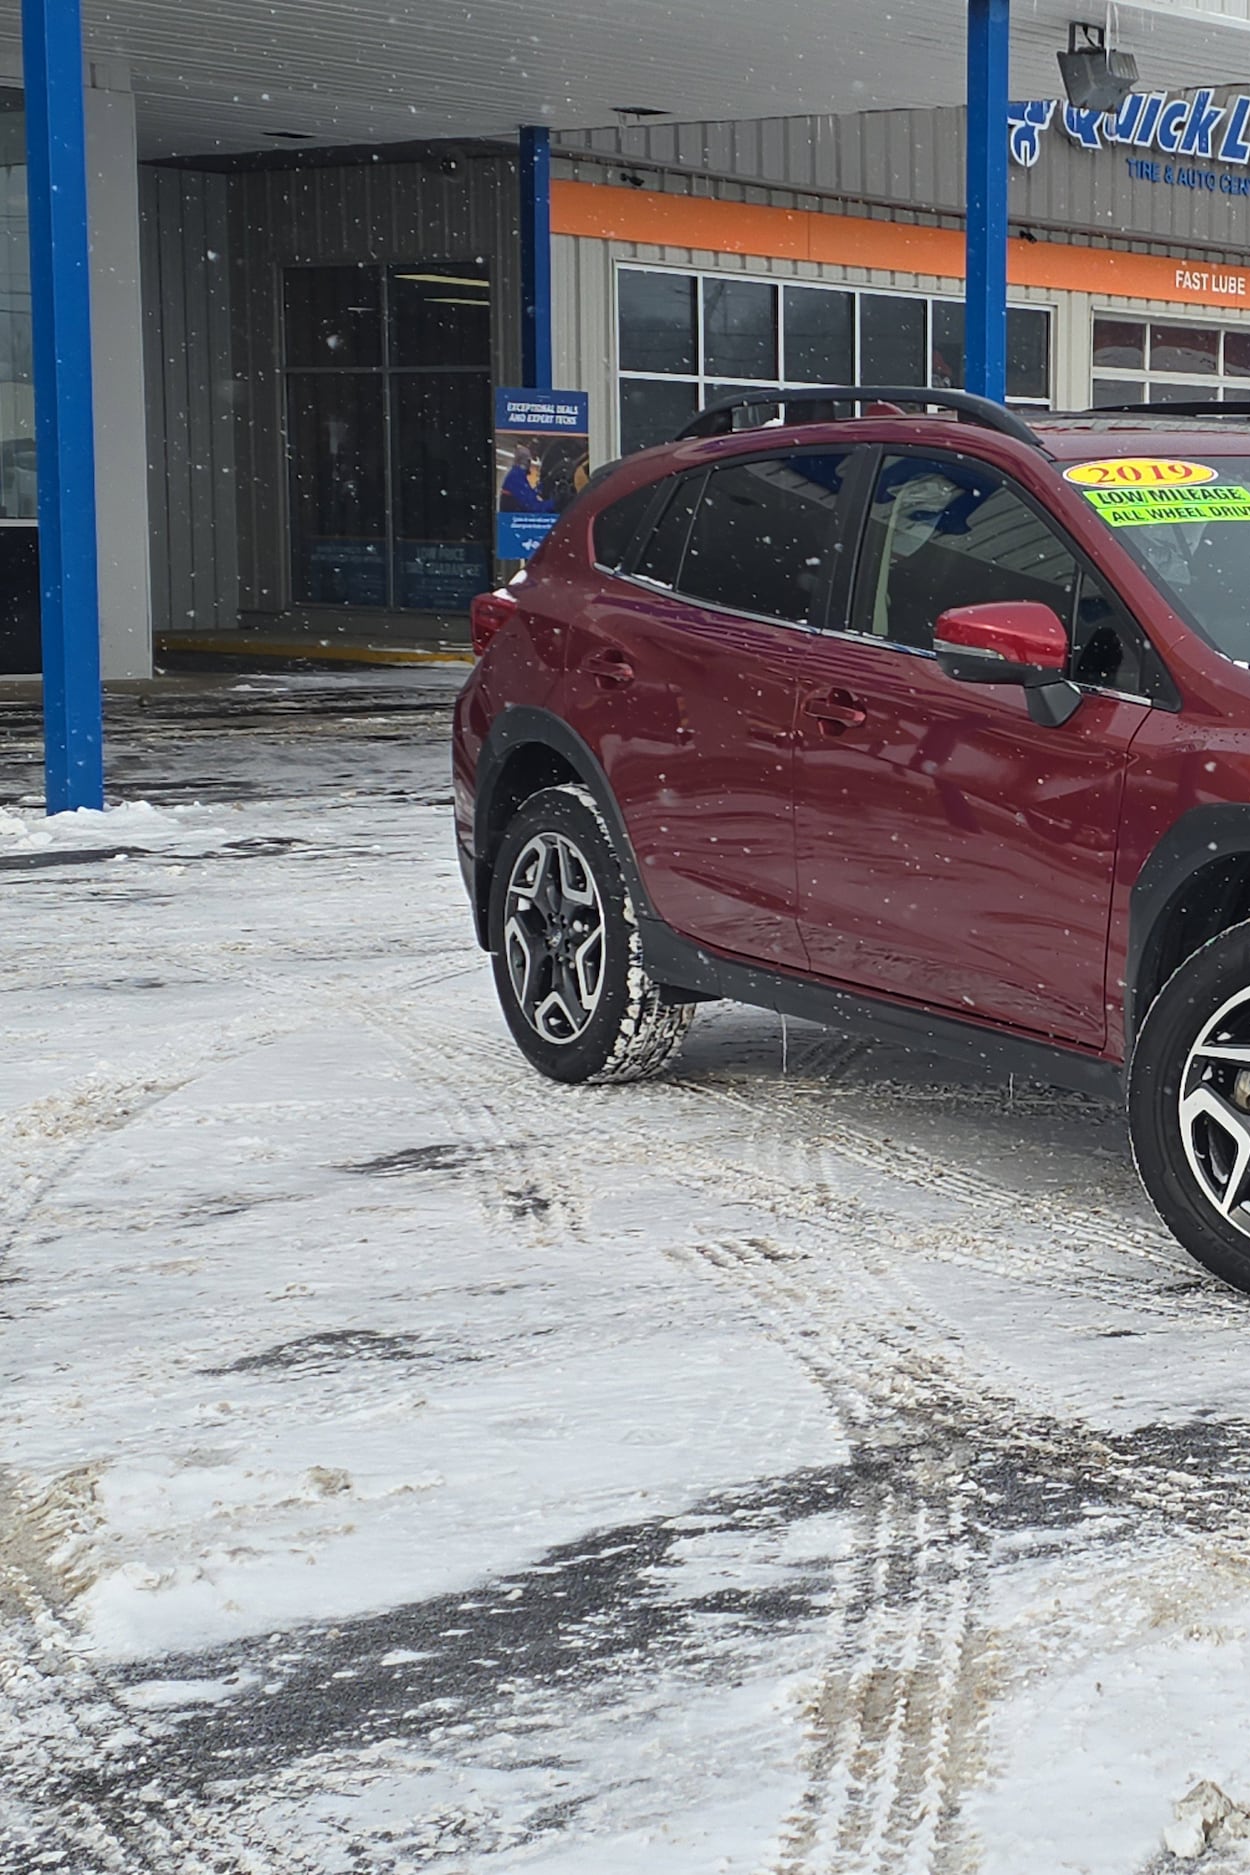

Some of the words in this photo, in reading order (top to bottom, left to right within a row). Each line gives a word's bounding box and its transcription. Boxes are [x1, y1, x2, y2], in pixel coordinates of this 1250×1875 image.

[1126, 158, 1160, 183] TIRE
[1164, 171, 1175, 184] &
[1177, 169, 1216, 192] AUTO
[1175, 269, 1208, 291] FAST
[1211, 274, 1246, 295] LUBE
[1087, 463, 1194, 484] 2019
[1097, 490, 1145, 505] LOW
[1149, 487, 1243, 503] MILEAGE
[1111, 509, 1141, 522] ALL
[1146, 507, 1208, 519] WHEEL
